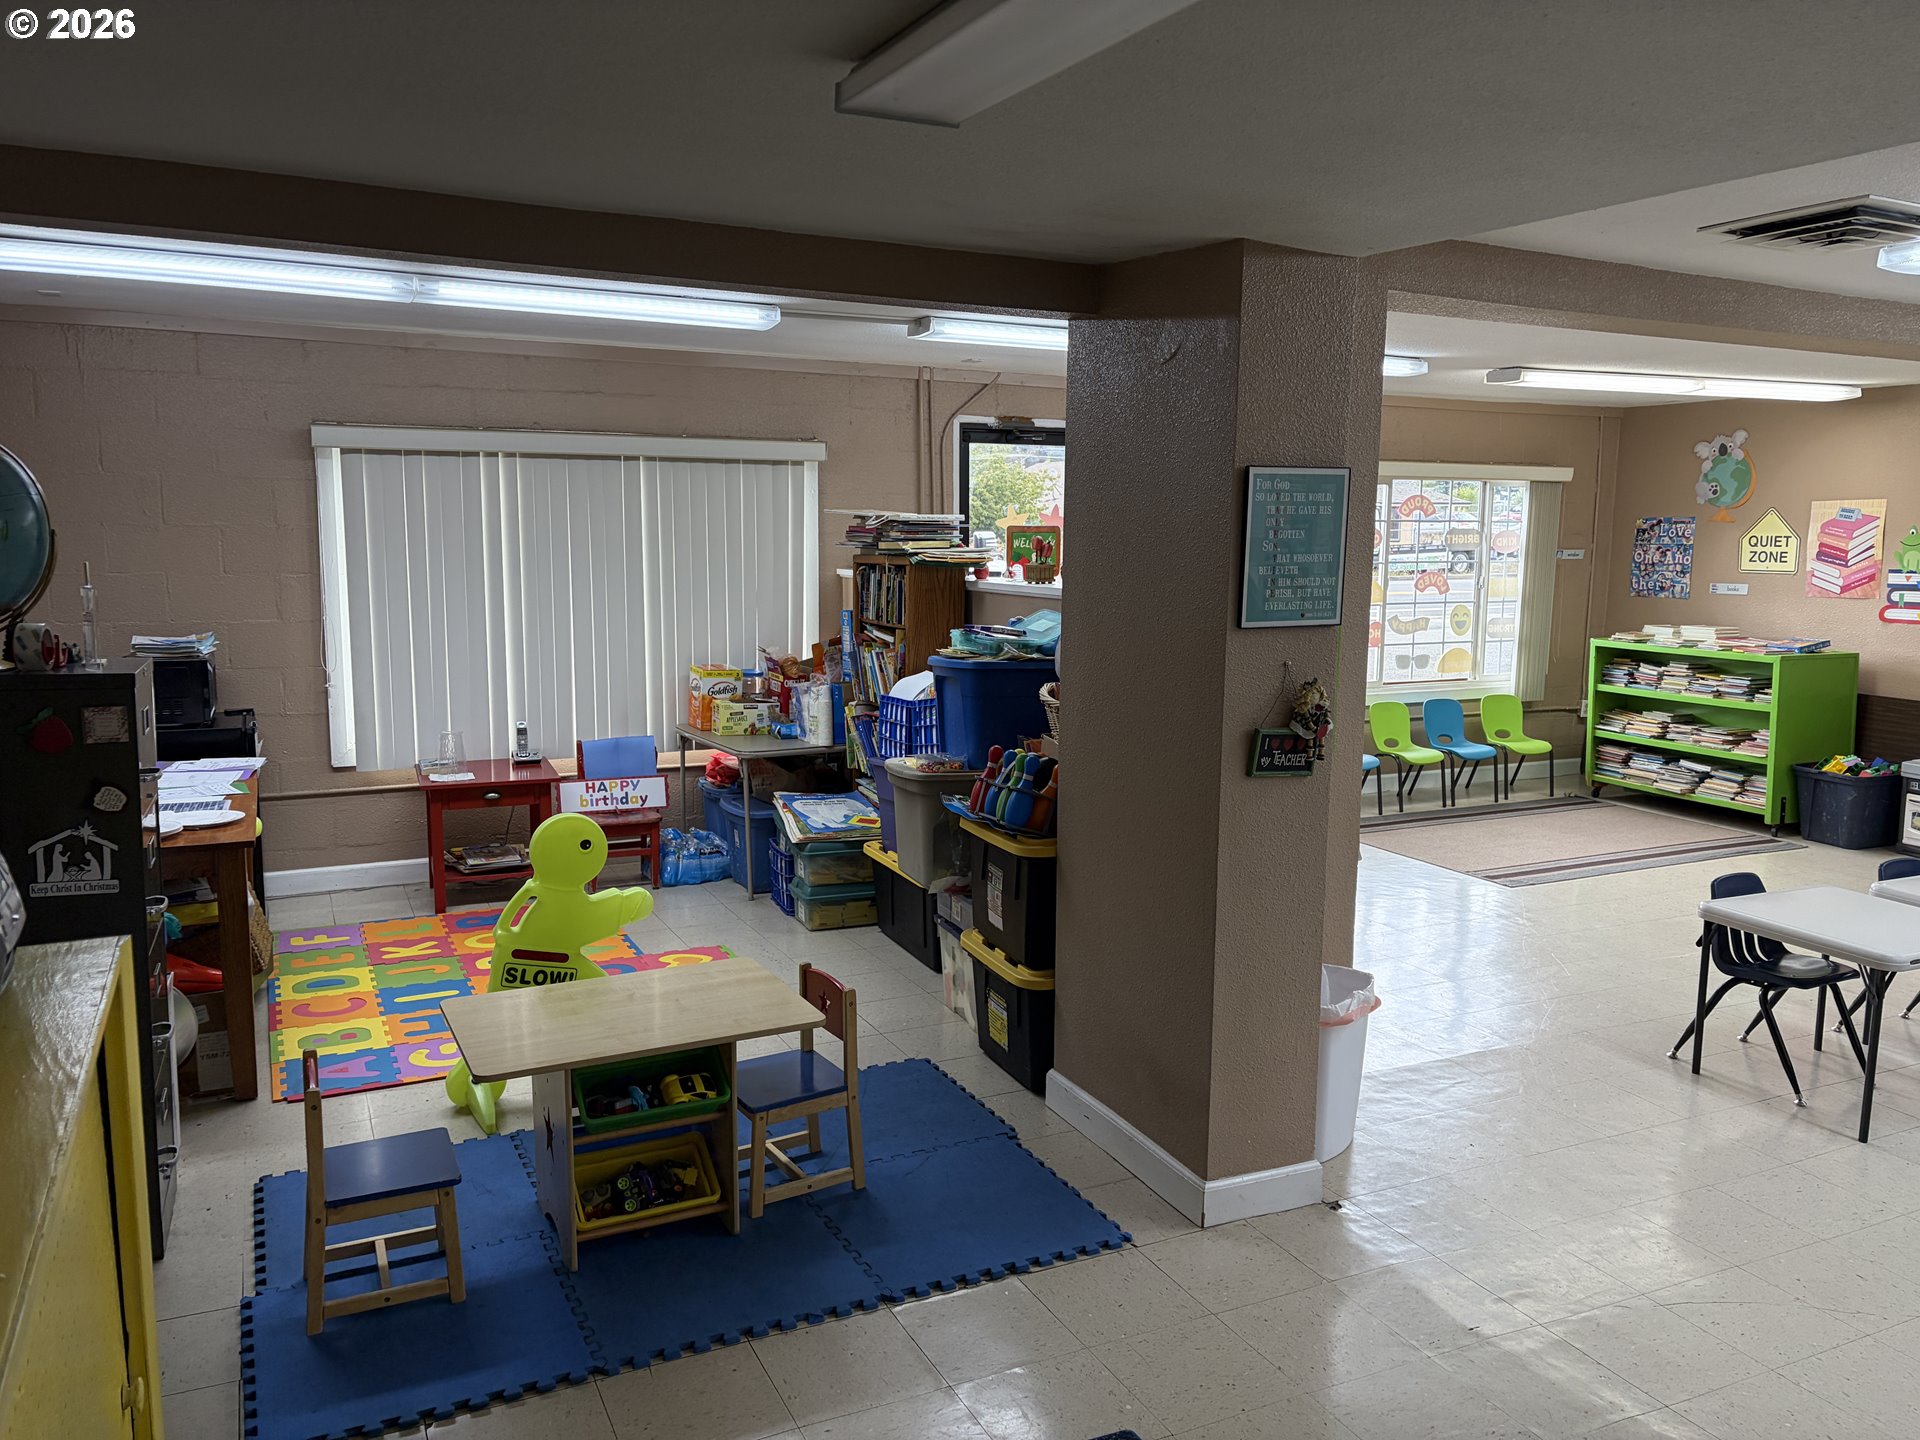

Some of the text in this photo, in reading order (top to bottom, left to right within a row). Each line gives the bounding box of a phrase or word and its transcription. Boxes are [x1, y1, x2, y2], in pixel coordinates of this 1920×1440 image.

[1255, 492, 1265, 502] SO
[1292, 492, 1306, 502] THE
[1286, 505, 1297, 515] HE
[1298, 505, 1317, 515] GAVE
[1319, 505, 1332, 515] HIS
[1748, 535, 1792, 548] QUIET
[1293, 553, 1334, 563] WHOSOEVER
[1634, 550, 1659, 564] One
[1748, 551, 1789, 563] ZONE
[1278, 577, 1292, 587] HIM
[1292, 577, 1321, 587] SHOULD
[1322, 576, 1336, 586] NOT
[1297, 588, 1311, 598] BUT
[1313, 587, 1331, 597] HAVE
[1264, 600, 1335, 611] EVERLASTING LIFE.
[707, 684, 738, 697] Goldfish
[585, 779, 640, 794] HAPPY
[579, 791, 648, 808] birthday
[31, 882, 119, 896] Keep Christ In Christmas
[504, 966, 575, 986] SLOW!
